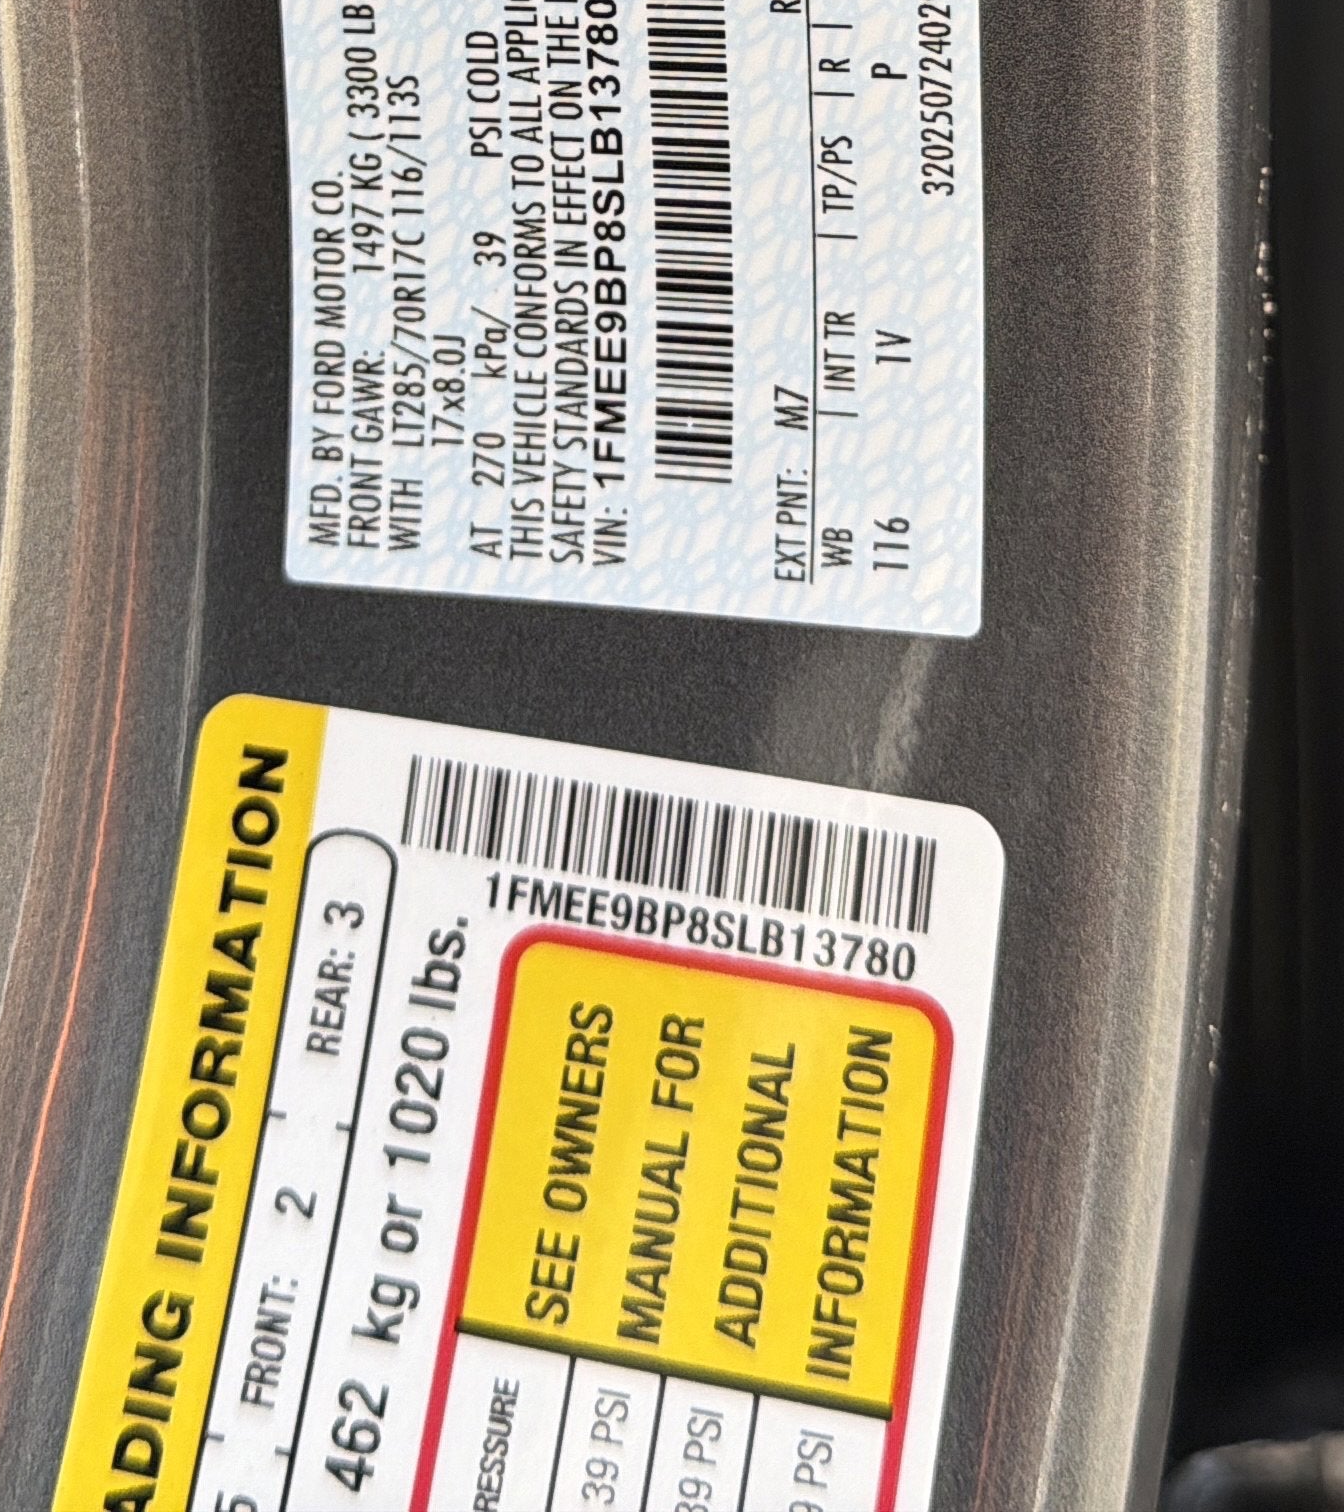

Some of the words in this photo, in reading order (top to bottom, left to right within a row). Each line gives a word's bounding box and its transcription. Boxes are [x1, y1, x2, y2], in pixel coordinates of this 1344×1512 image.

[466, 31, 501, 104] COLD
[545, 15, 580, 67] THE
[818, 59, 850, 73] R
[870, 63, 907, 79] P
[344, 47, 380, 119] 3300
[509, 93, 543, 143] ALL
[548, 80, 583, 120] ON
[351, 153, 383, 190] KG
[387, 75, 427, 217] 116/113S
[471, 116, 502, 157] PSI
[513, 154, 544, 189] TO
[311, 171, 343, 215] CO.
[551, 131, 586, 224] EFFECT
[820, 135, 857, 214] TP/PS
[353, 204, 385, 274] 1497
[474, 231, 505, 268] 39
[553, 239, 586, 267] IN
[314, 228, 345, 329] MOTOR
[513, 201, 548, 359] CONFORMS
[391, 233, 429, 447] LT285/70R17C
[472, 306, 509, 378] kPa/
[824, 312, 854, 339] TR
[312, 341, 344, 414] FORD
[352, 350, 385, 443] GAWR:
[432, 334, 465, 446] 17x8.0J
[554, 280, 589, 450] STANDARDS
[824, 348, 854, 391] INT
[513, 370, 547, 484] VEHICLE
[775, 385, 809, 431] M7
[311, 427, 342, 461] BY
[473, 433, 504, 488] 270
[309, 476, 342, 546] MFD.
[350, 453, 384, 550] FRONT
[389, 479, 423, 551] WITH
[511, 498, 545, 560] THIS
[551, 459, 586, 564] SAFETY
[776, 468, 808, 525] PNT:
[471, 523, 504, 559] AT
[593, 508, 627, 567] VIN:
[775, 533, 806, 583] EXT
[822, 528, 853, 568] WB
[873, 517, 910, 570] 116
[323, 900, 365, 929] 3
[484, 874, 916, 982] 1FMEE9BP8SLB13780
[408, 916, 469, 1010] lbs.
[156, 743, 289, 1263] INFORMATION
[306, 949, 355, 1056] REAR:
[650, 1014, 706, 1110] FOR
[383, 1027, 450, 1169] 1020
[542, 1000, 616, 1212] OWNERS
[380, 1193, 422, 1253] or
[713, 1042, 795, 1348] ADDITIONAL
[806, 1024, 892, 1382] INFORMATION
[616, 1128, 692, 1345] MANUAL
[240, 1275, 298, 1410] FRONT:
[274, 1186, 317, 1219] 2
[351, 1274, 420, 1344] kg
[525, 1228, 583, 1326] SEE
[324, 1378, 389, 1492] 462
[589, 1387, 631, 1446] PSI
[682, 1407, 724, 1464] PSI
[581, 1457, 619, 1505] 39
[792, 1428, 835, 1489] PSI
